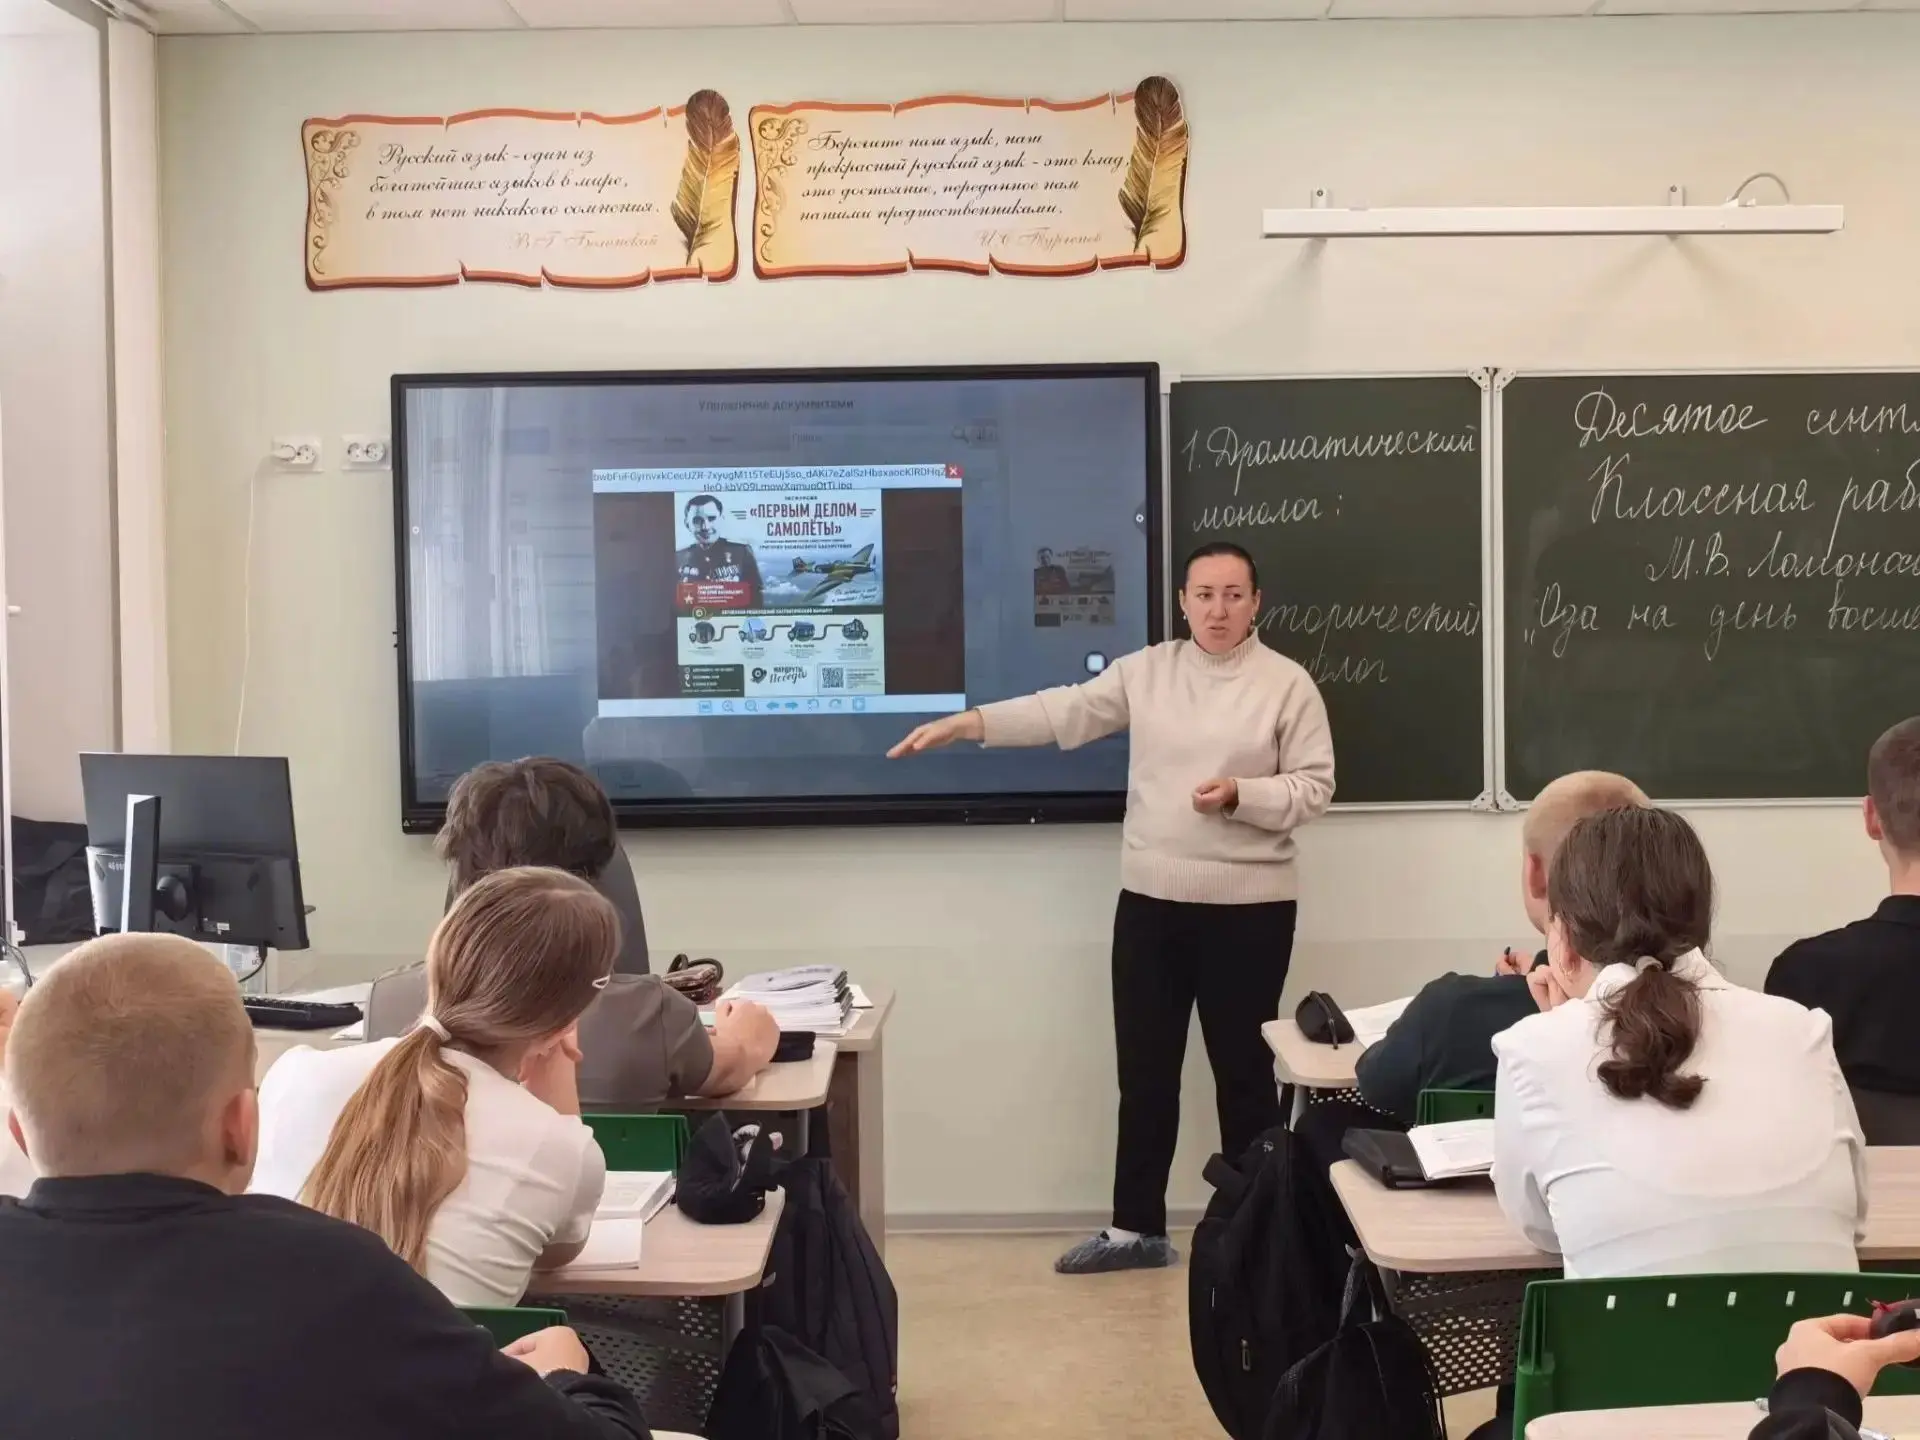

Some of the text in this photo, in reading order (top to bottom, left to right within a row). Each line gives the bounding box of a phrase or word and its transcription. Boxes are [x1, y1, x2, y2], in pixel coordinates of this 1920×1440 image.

[807, 128, 1043, 156] Берегите наш язык, наш
[379, 143, 457, 174] Русский
[462, 144, 509, 171] язык
[573, 149, 595, 167] из
[806, 156, 907, 180] прекрасный
[905, 153, 979, 179] русский
[982, 151, 1026, 175] язык
[1043, 158, 1078, 168] это
[369, 175, 485, 193] богатейших
[489, 170, 558, 196] языков
[560, 168, 574, 188] в
[802, 180, 1080, 204] это достояние, переданное нам
[365, 198, 660, 220] в том нет никакого сомнения.
[800, 209, 872, 221] нашими
[772, 398, 853, 412] документами
[1573, 384, 1920, 448] Десятое сент
[1206, 424, 1478, 497] Драматический
[750, 501, 857, 519] «ПЕРВЫМ ДЕЛОМ
[1587, 453, 1920, 558] Классная раб
[766, 518, 842, 537] САМОЛЁТЫ»
[1254, 601, 1482, 673] торический
[1627, 603, 1676, 630] на
[1703, 600, 1797, 661] день
